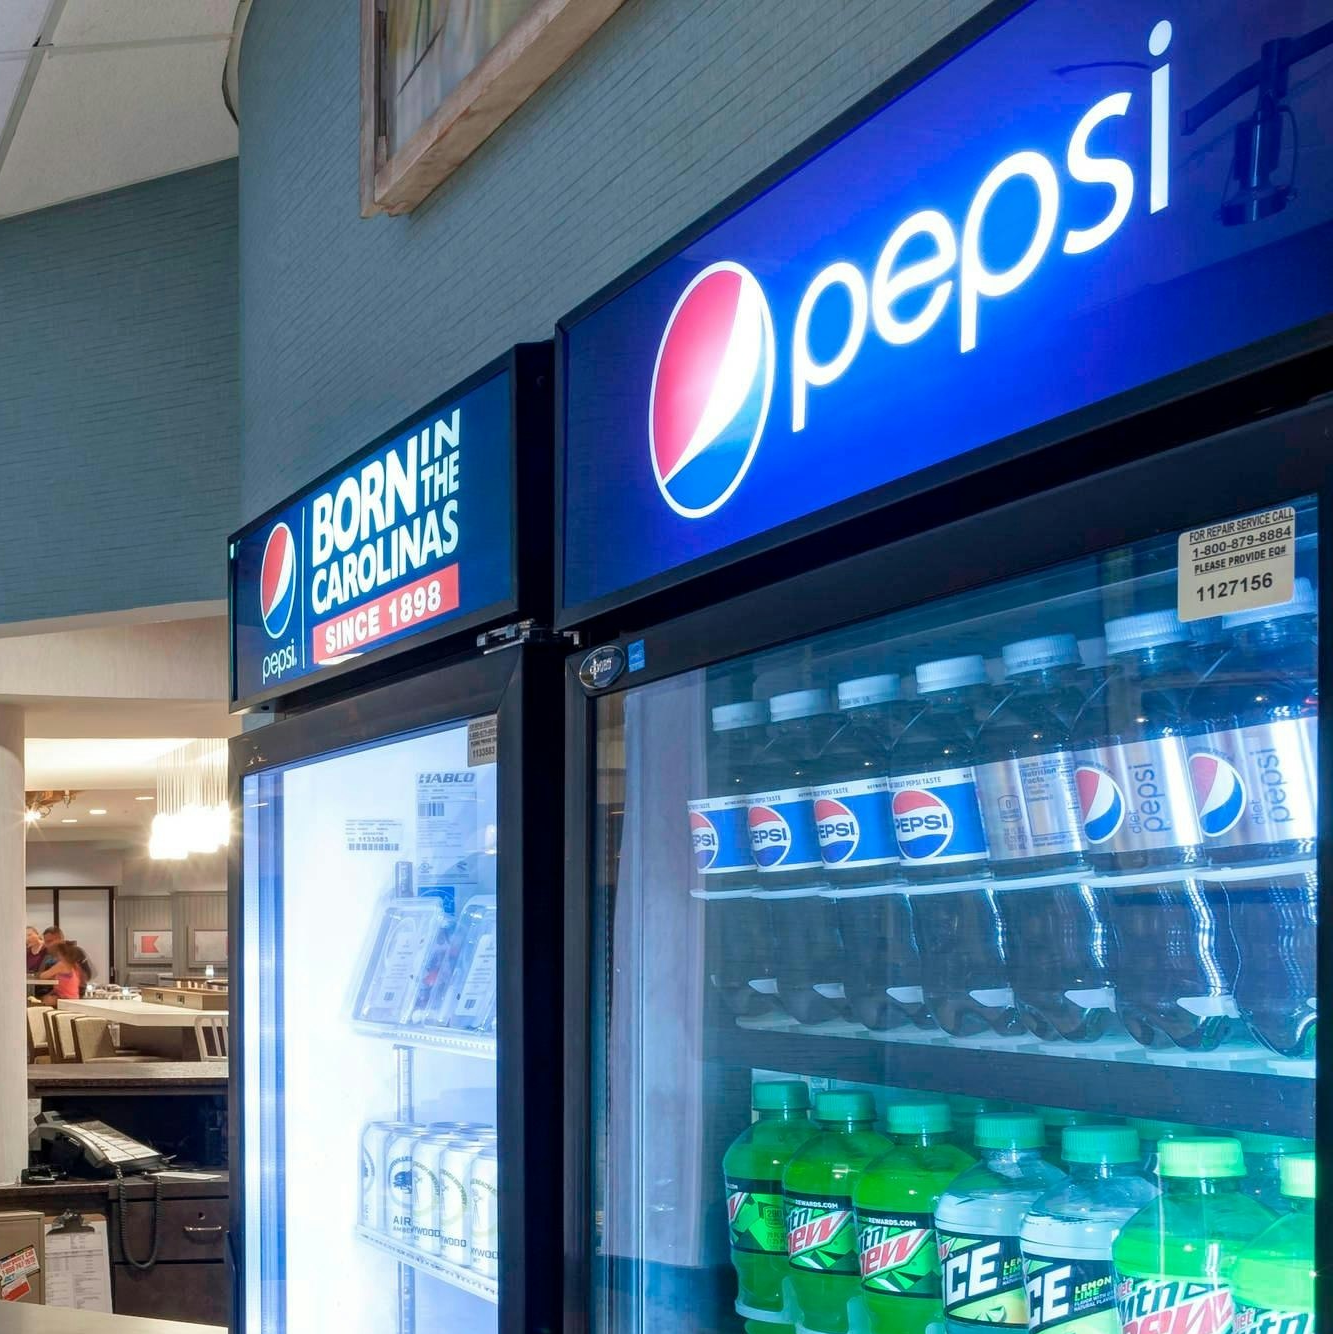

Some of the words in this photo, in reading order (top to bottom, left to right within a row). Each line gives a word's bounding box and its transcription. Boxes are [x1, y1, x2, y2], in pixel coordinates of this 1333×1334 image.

[792, 20, 1172, 433] pepsi
[313, 435, 417, 567] BORN
[420, 408, 460, 465] IN
[421, 450, 460, 507] THE
[1189, 529, 1205, 542] FOR
[1207, 522, 1235, 537] REPAIR
[1237, 513, 1270, 530] SERVICE
[1273, 507, 1294, 522] CALL
[1193, 525, 1291, 558] 1-800-879-8884
[311, 499, 459, 615] CAROLINAS
[1194, 558, 1226, 575] PLEASE
[1228, 549, 1266, 567] PROVIDE
[1268, 544, 1286, 557] EQ#
[1197, 572, 1273, 601] 1127156
[325, 605, 380, 653] SINCE
[388, 580, 441, 628] 1898
[263, 638, 298, 685] pepsi
[419, 772, 475, 784] HABCO
[922, 775, 941, 785] TASTE
[1250, 747, 1295, 825] pepsi
[1129, 763, 1172, 834] pepsi
[895, 814, 948, 832] PEPSI
[1132, 809, 1143, 835] diet
[1075, 1275, 1111, 1295] LEMON
[1075, 1288, 1100, 1302] LIME
